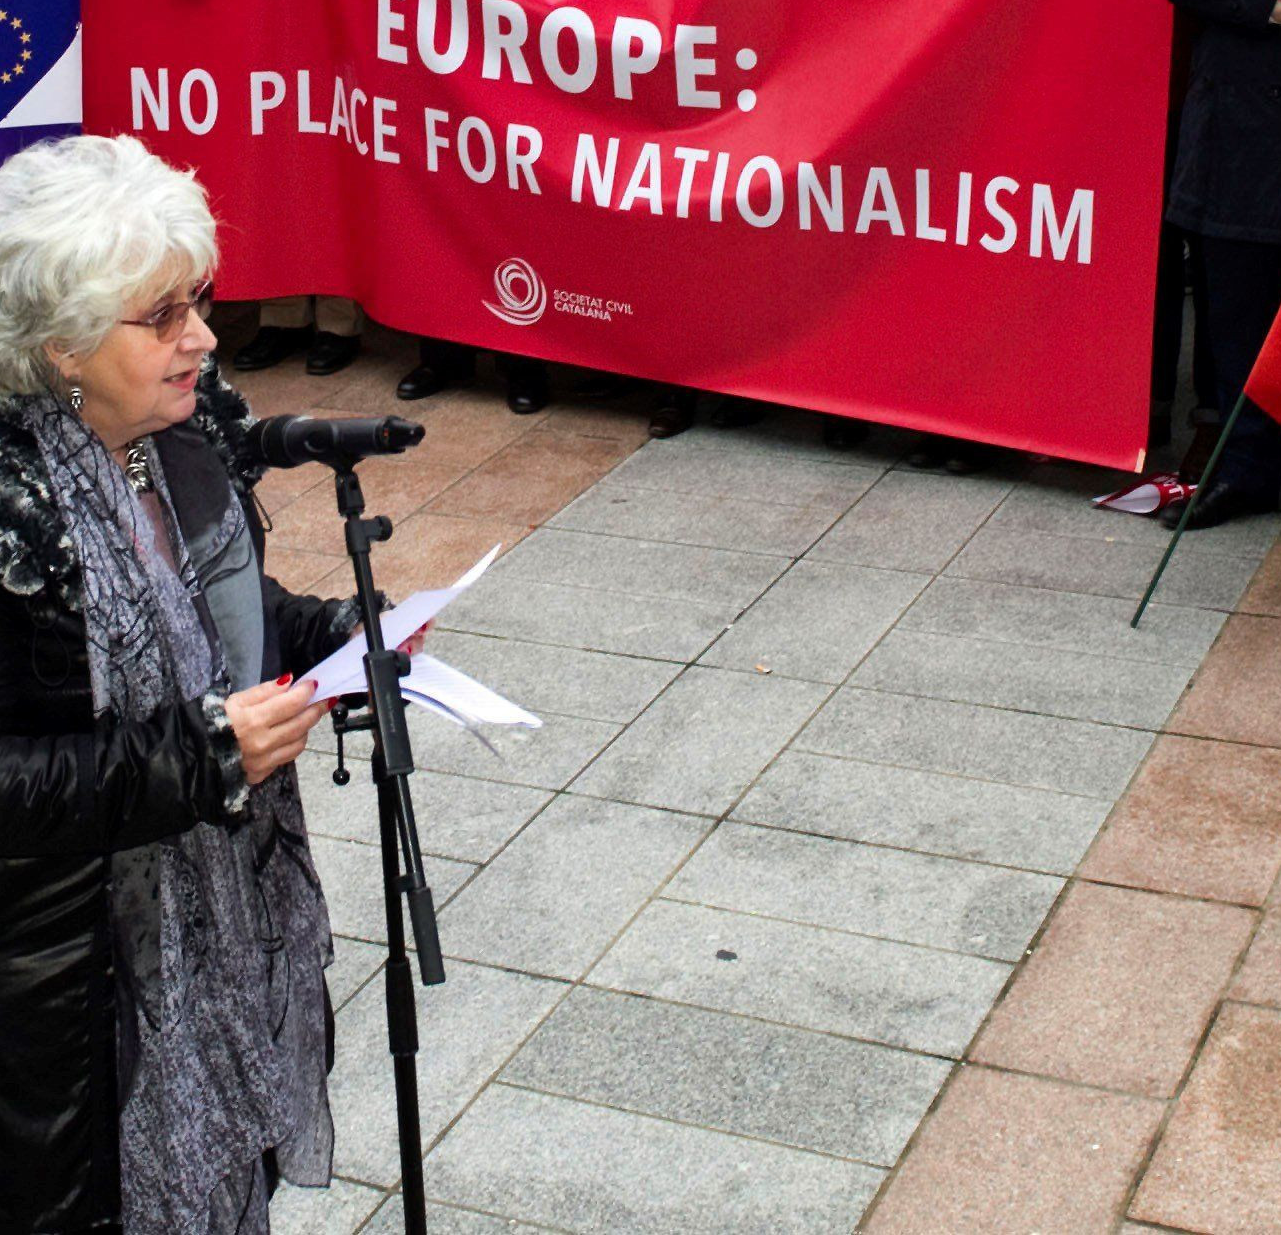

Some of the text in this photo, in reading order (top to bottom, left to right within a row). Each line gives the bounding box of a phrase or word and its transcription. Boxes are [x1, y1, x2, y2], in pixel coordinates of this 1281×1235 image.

[129, 66, 1095, 266] NO PLACE FOR NATIONALISM
[554, 289, 634, 315] SOCIETAT CIVIL
[554, 301, 612, 322] CATALANA
